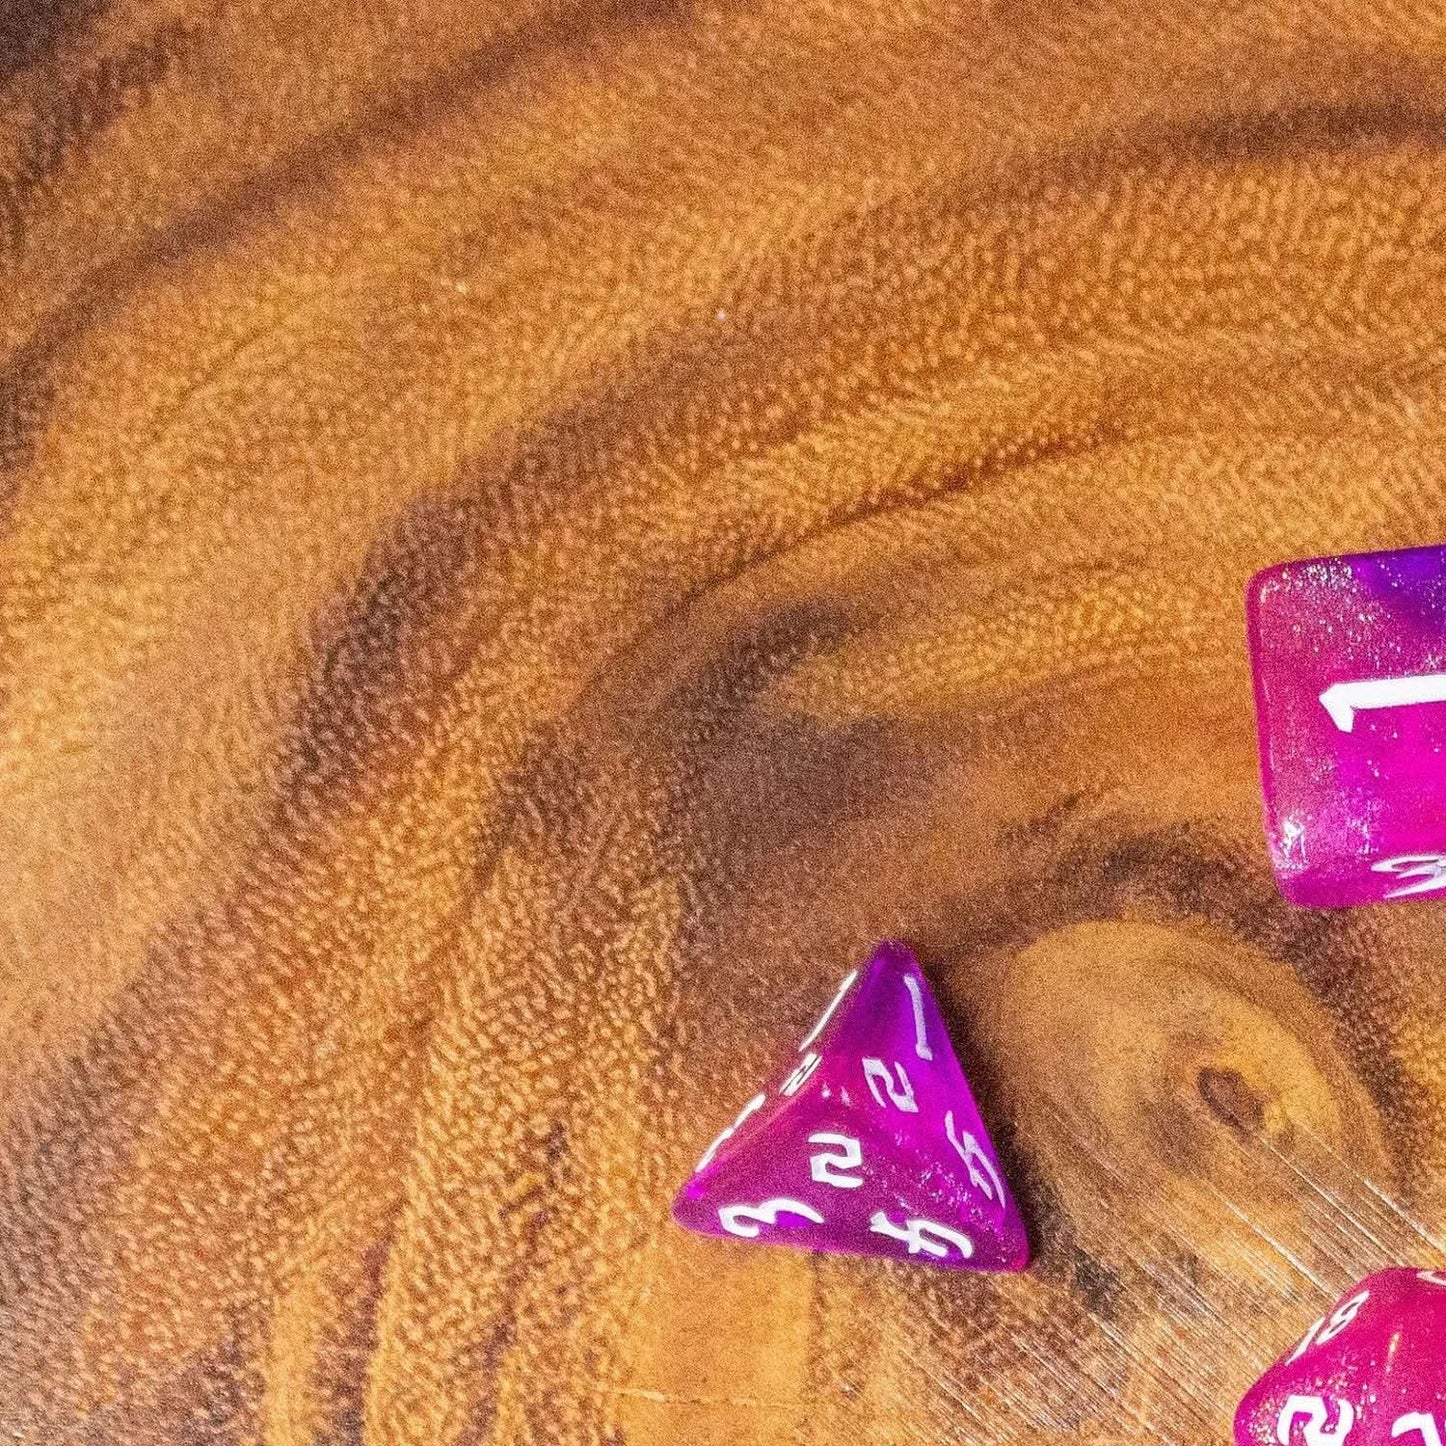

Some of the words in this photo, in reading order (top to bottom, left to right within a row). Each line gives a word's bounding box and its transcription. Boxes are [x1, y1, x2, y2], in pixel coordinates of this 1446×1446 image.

[862, 1056, 918, 1114] 2
[807, 1133, 864, 1189] 2
[718, 1197, 824, 1239] 3
[870, 1210, 974, 1260] 4
